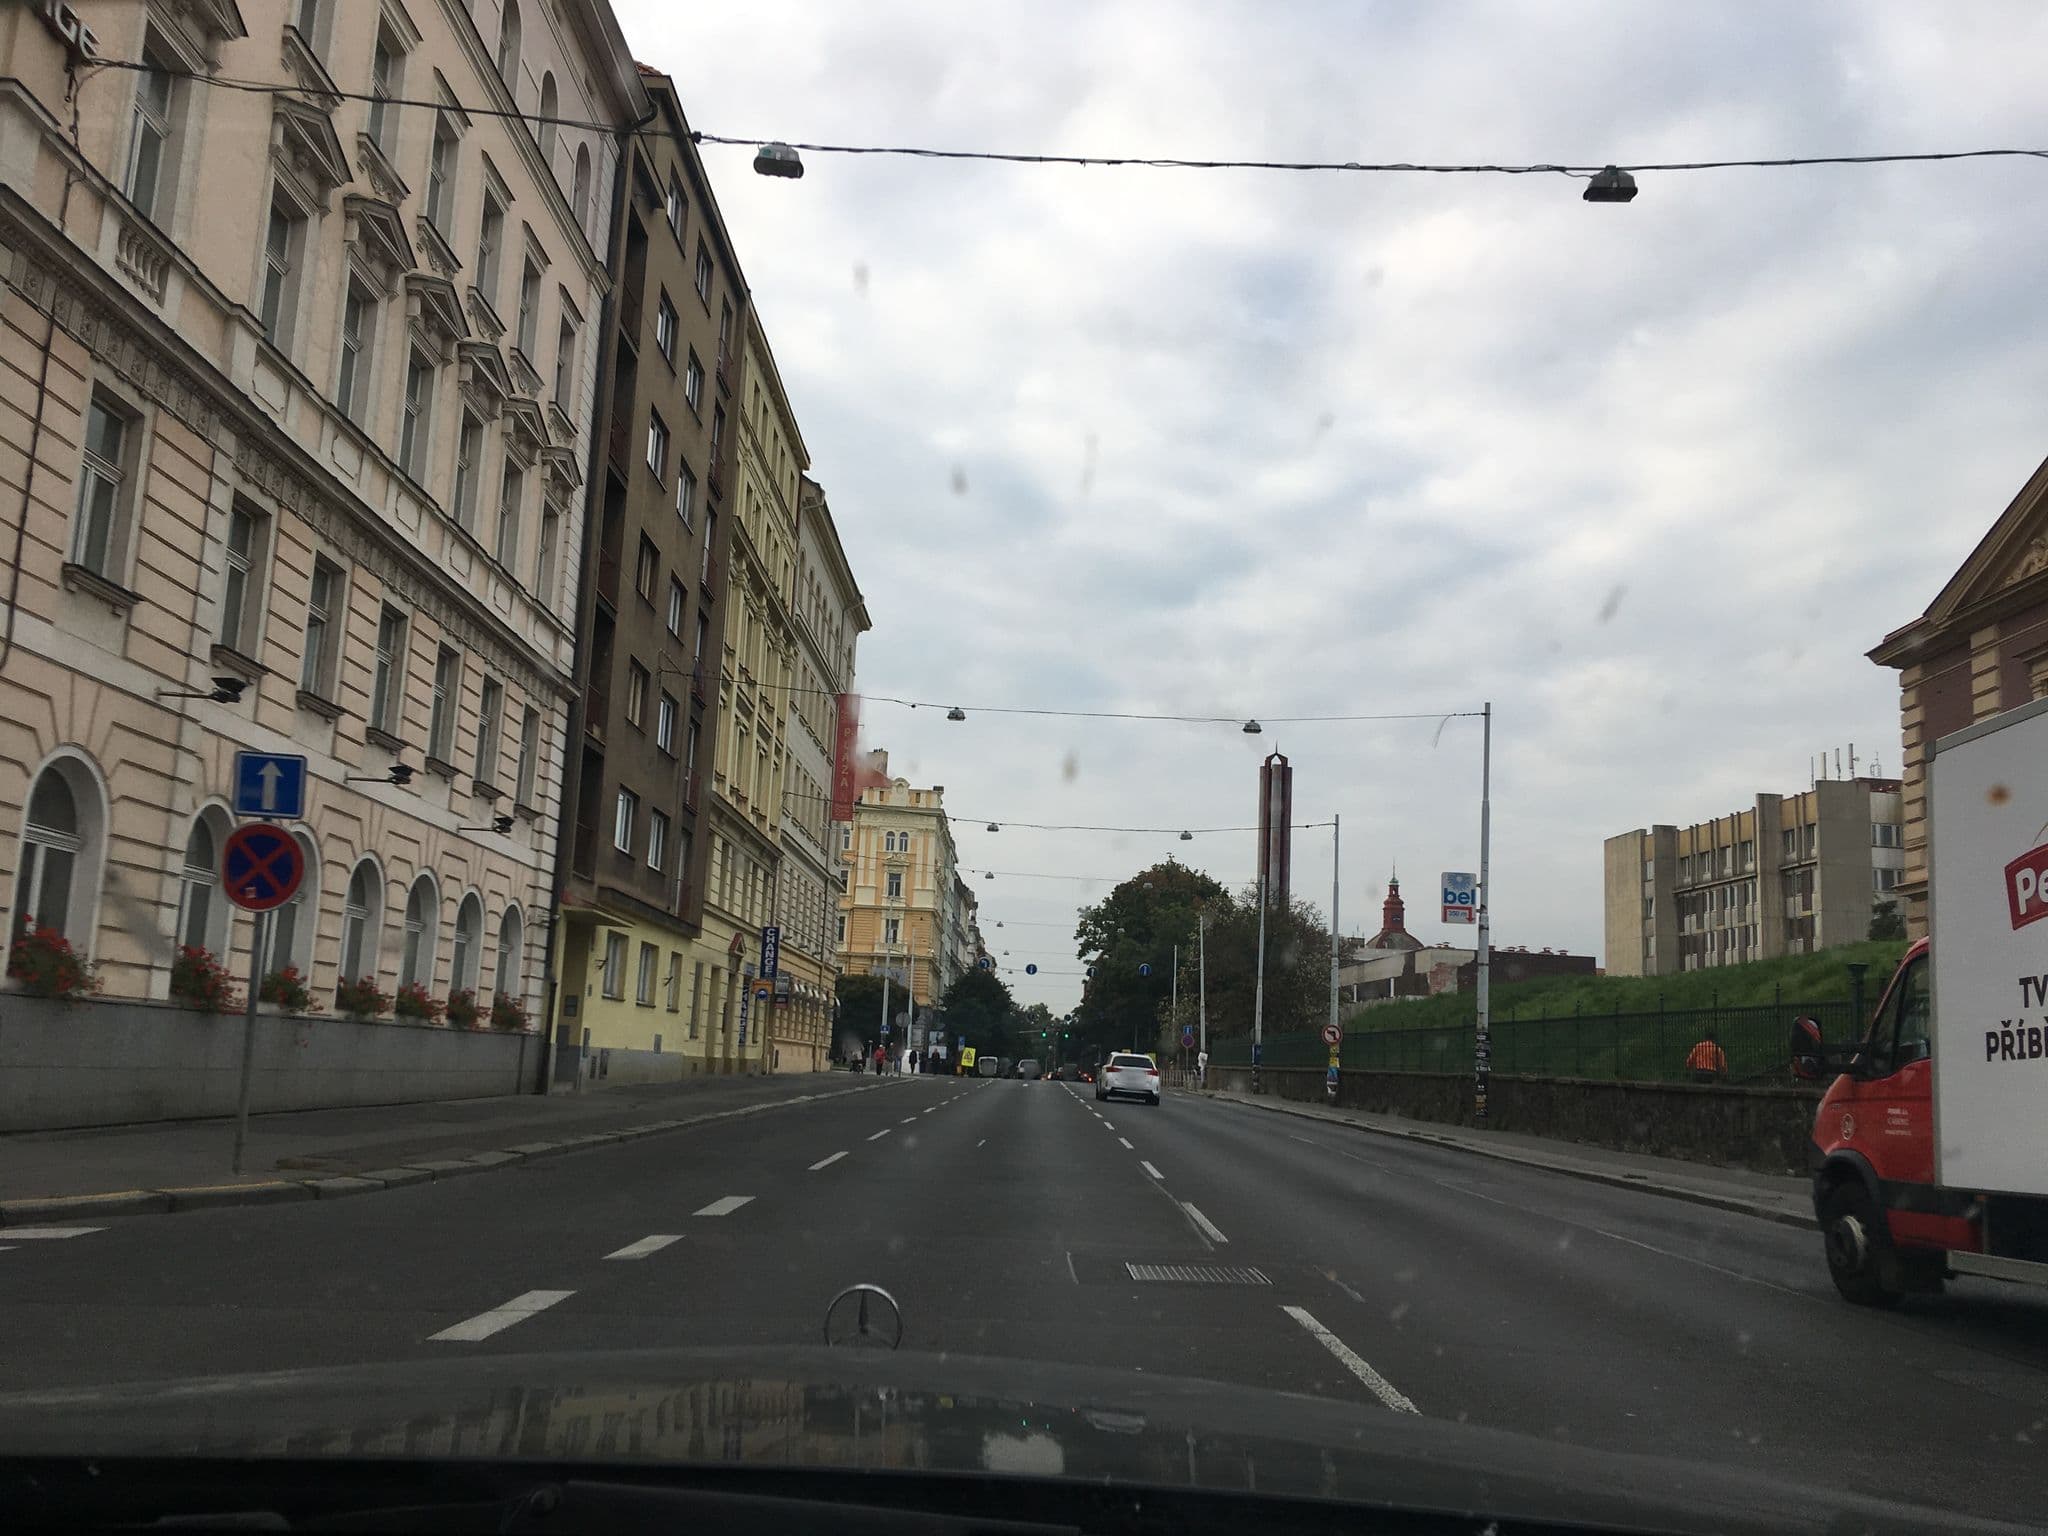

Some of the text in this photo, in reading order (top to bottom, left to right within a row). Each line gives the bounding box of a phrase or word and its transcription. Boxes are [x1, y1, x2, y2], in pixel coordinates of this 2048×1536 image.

[1443, 887, 1475, 905] bel
[764, 928, 776, 973] CHANGE
[2019, 974, 2048, 1008] TV
